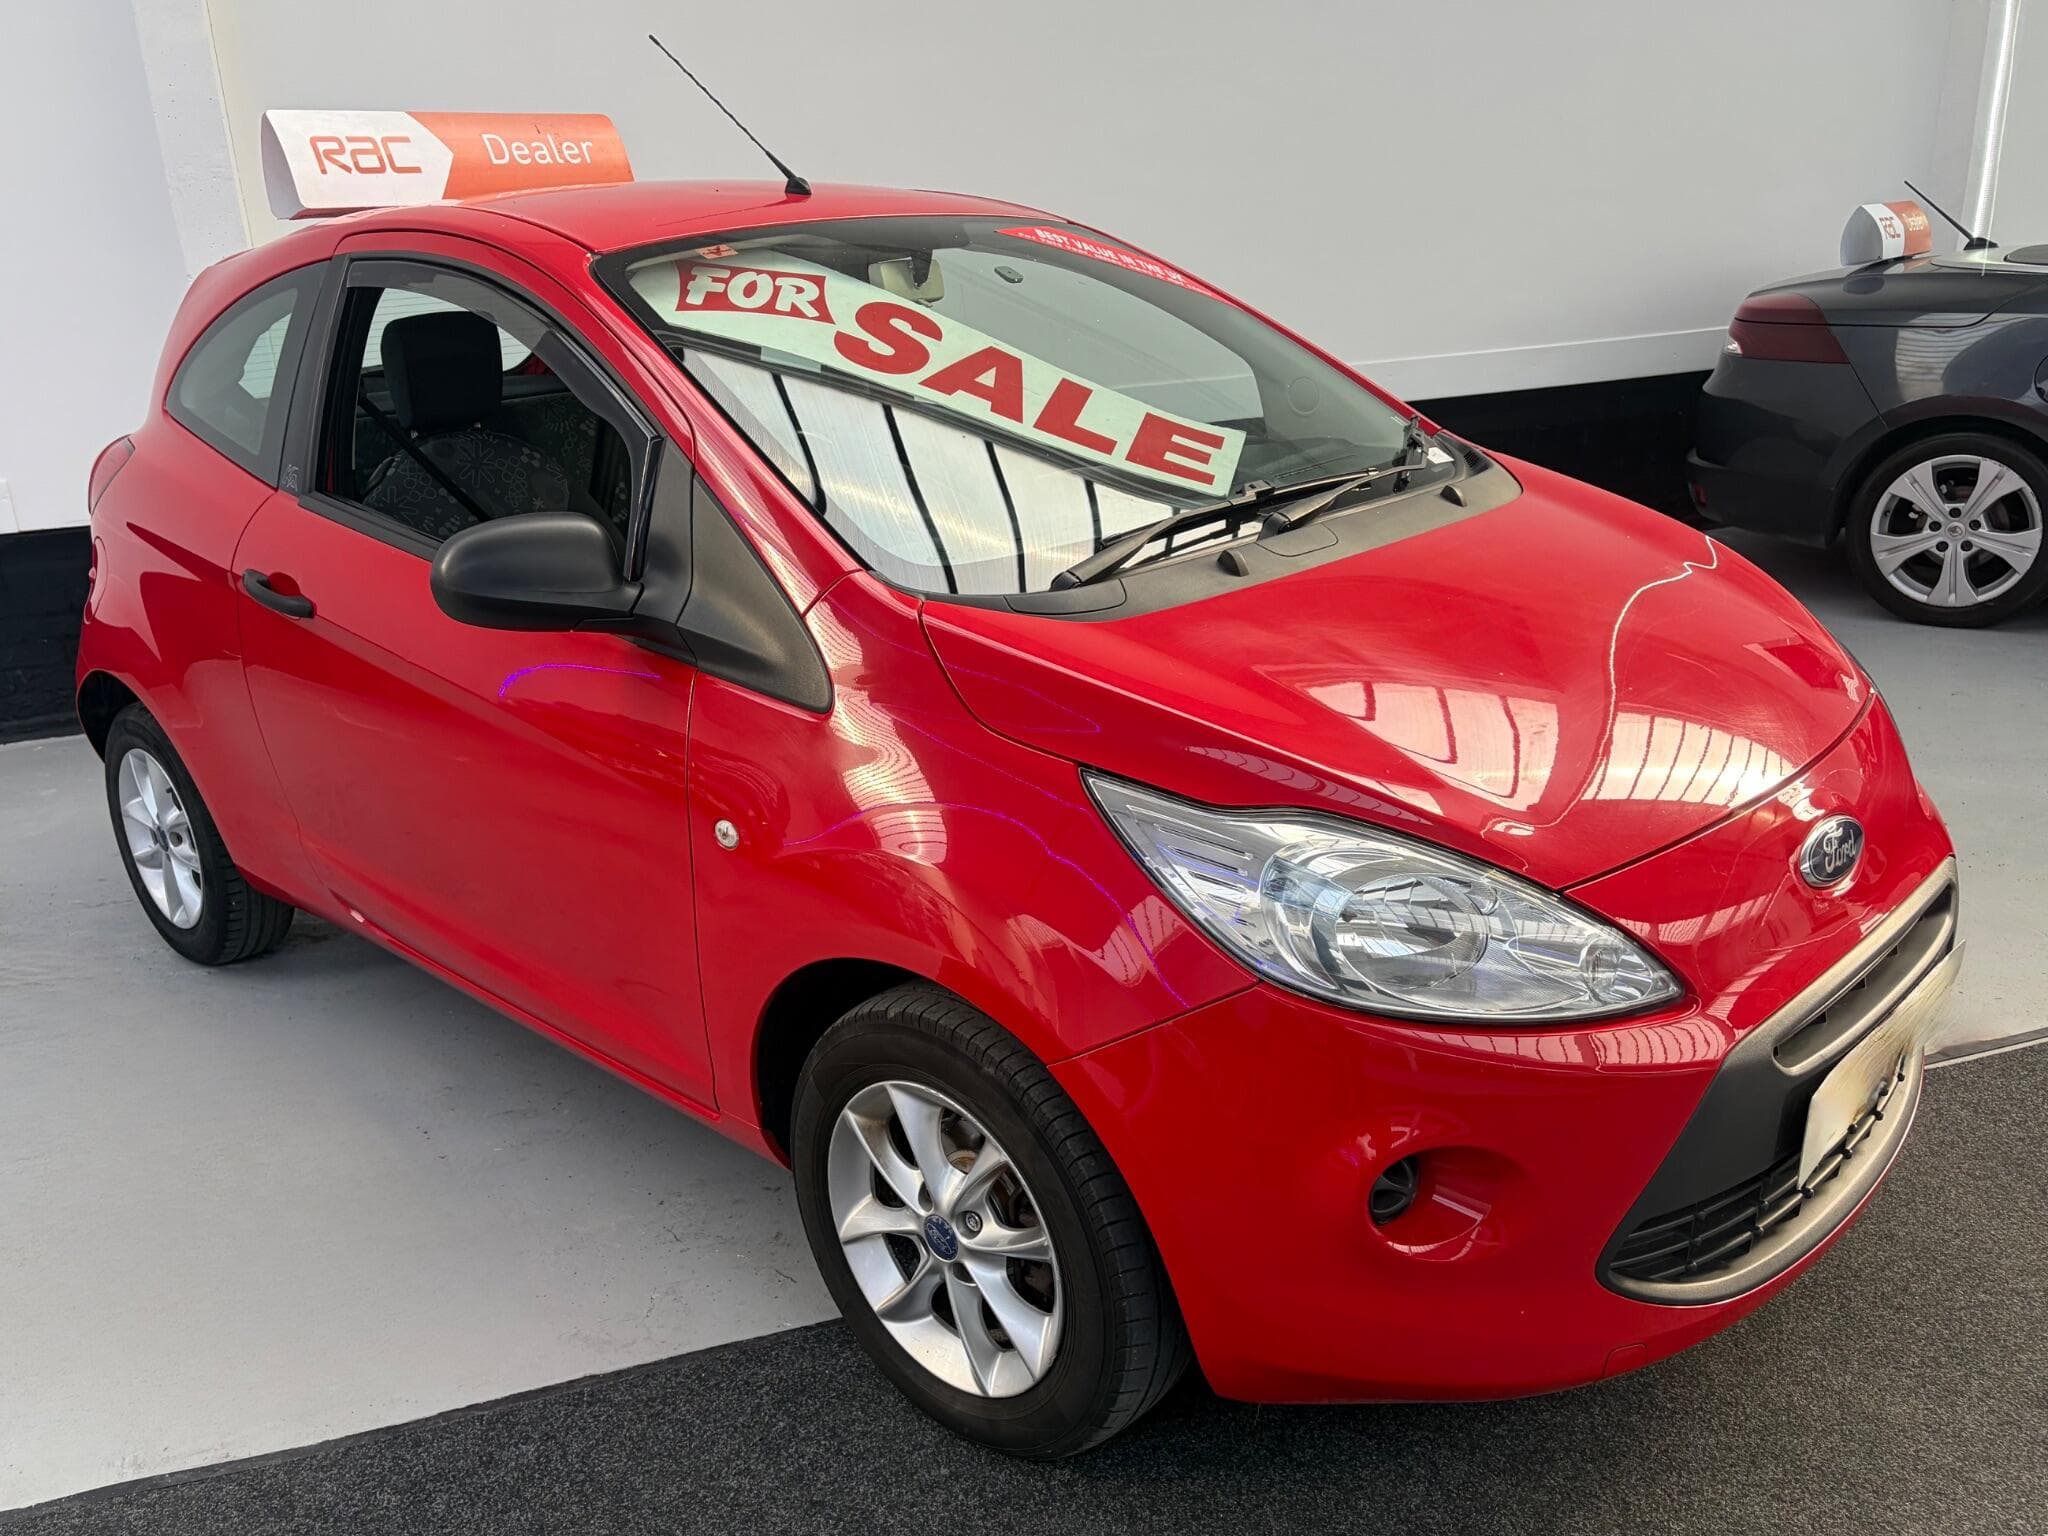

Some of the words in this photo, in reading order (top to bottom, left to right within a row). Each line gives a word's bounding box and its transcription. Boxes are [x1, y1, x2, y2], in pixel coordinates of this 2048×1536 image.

[481, 132, 594, 166] Dealer
[1034, 228, 1070, 245] BEST
[1070, 238, 1119, 260] VALUE
[1118, 253, 1137, 266] IN
[1134, 259, 1166, 276] THE
[685, 265, 820, 319] FOR
[833, 301, 1224, 486] SALE
[1823, 826, 1858, 874] Ford
